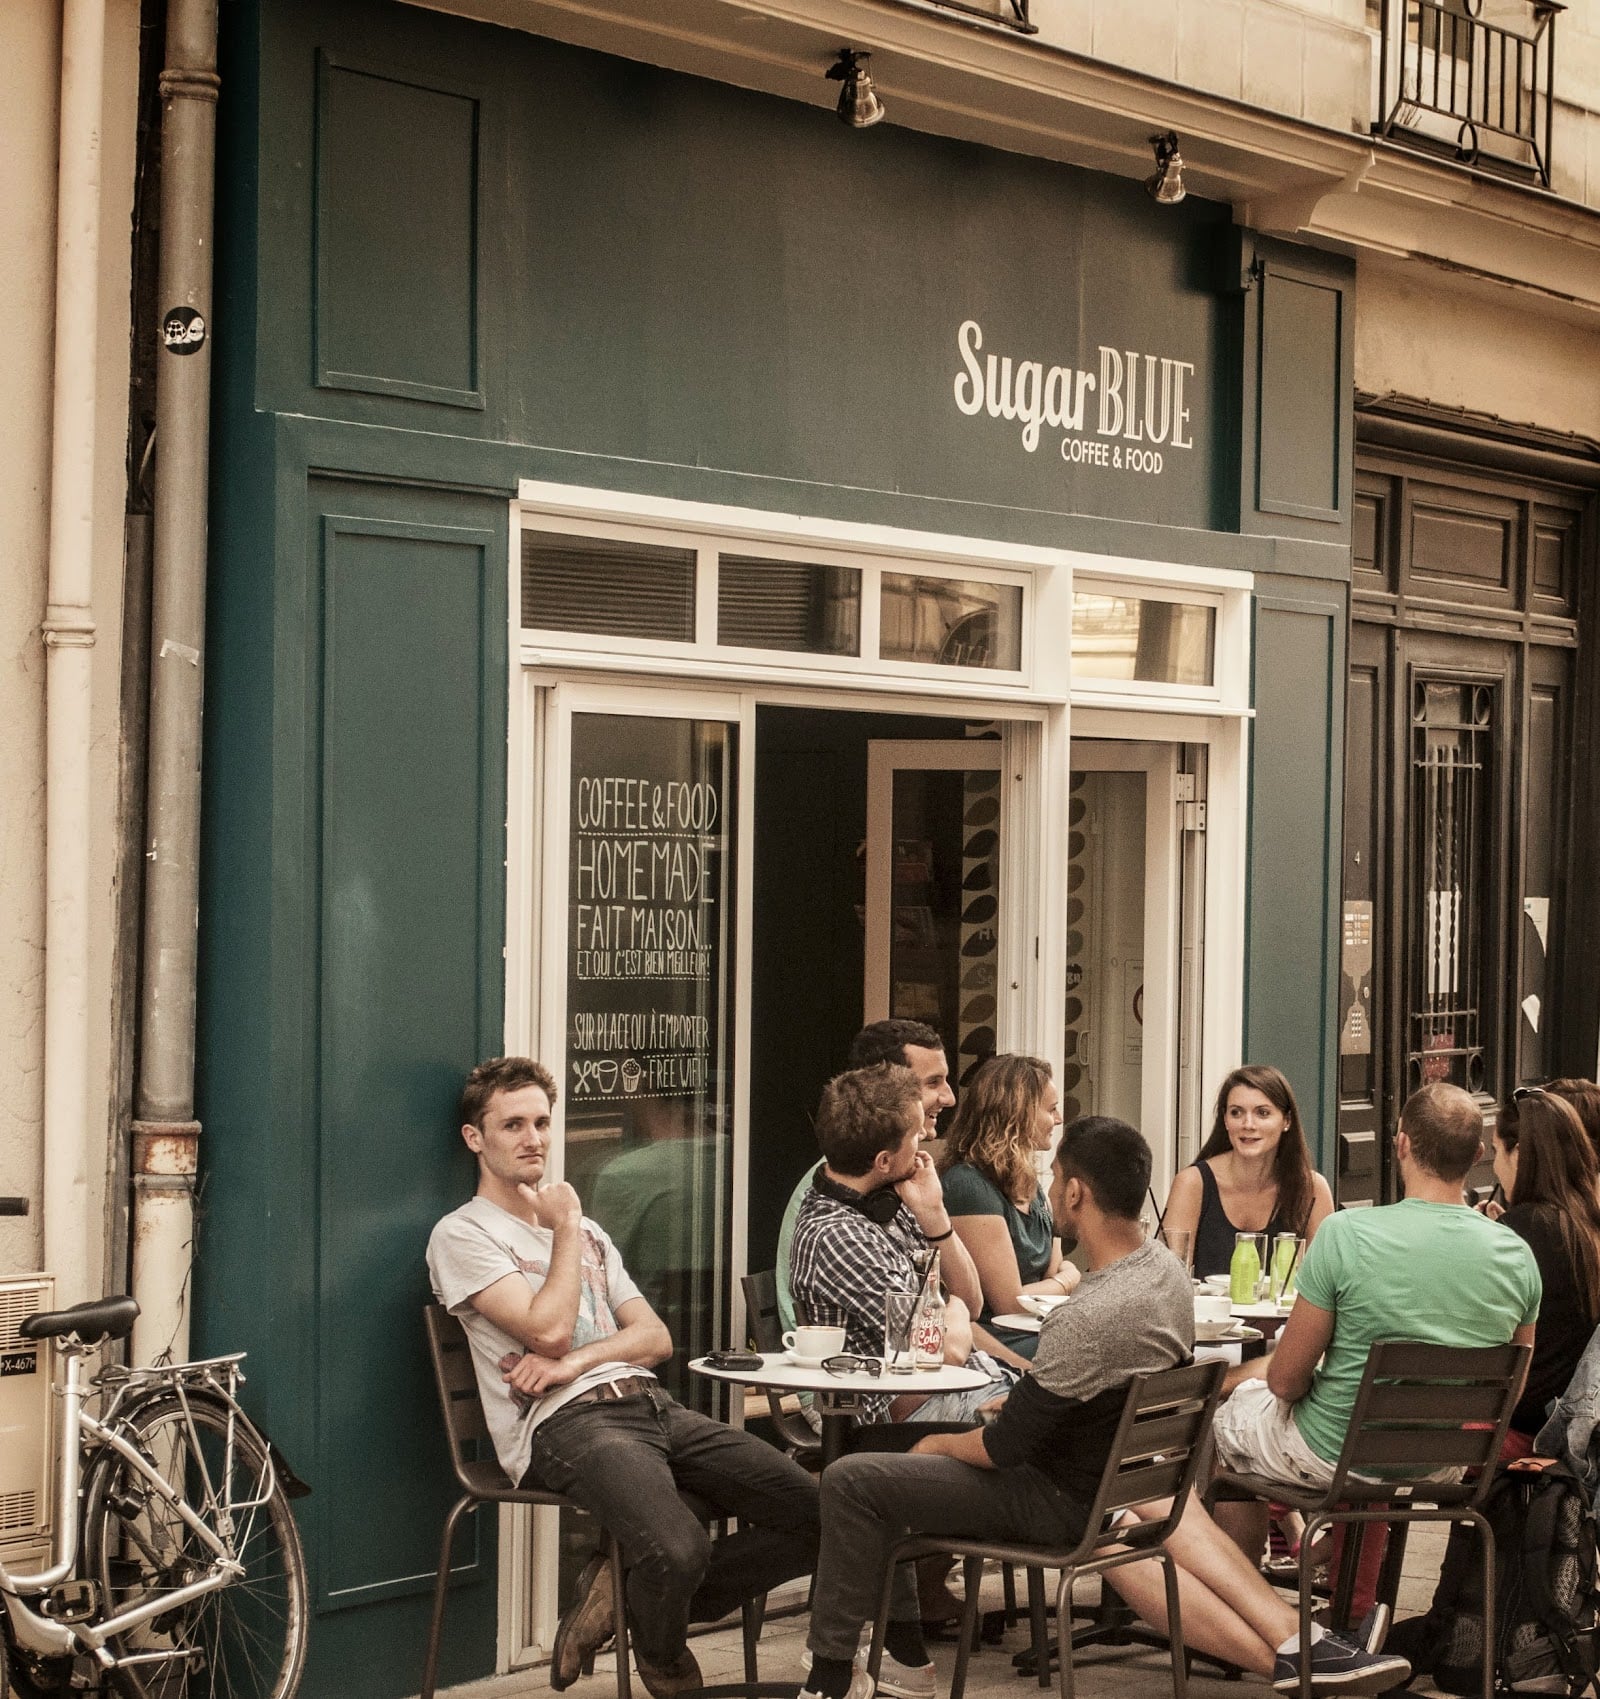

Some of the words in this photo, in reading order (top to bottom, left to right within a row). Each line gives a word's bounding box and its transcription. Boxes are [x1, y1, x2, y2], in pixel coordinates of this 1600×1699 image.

[954, 320, 1096, 452] Sugar
[1097, 346, 1194, 448] BLUE
[1060, 437, 1109, 467] COFFEE
[1112, 445, 1123, 469] &
[1125, 447, 1164, 474] FOOD
[577, 905, 626, 950] FAIT
[577, 950, 591, 977] ET
[593, 950, 611, 977] OUI
[615, 949, 643, 977] C'EST
[644, 950, 664, 976] BIEN
[573, 1012, 595, 1051] SUR
[597, 1012, 630, 1052] PLACE
[630, 1013, 646, 1051] OU
[649, 1008, 657, 1050] À
[659, 1013, 710, 1050] EMPORTER
[649, 1058, 677, 1090] FREE
